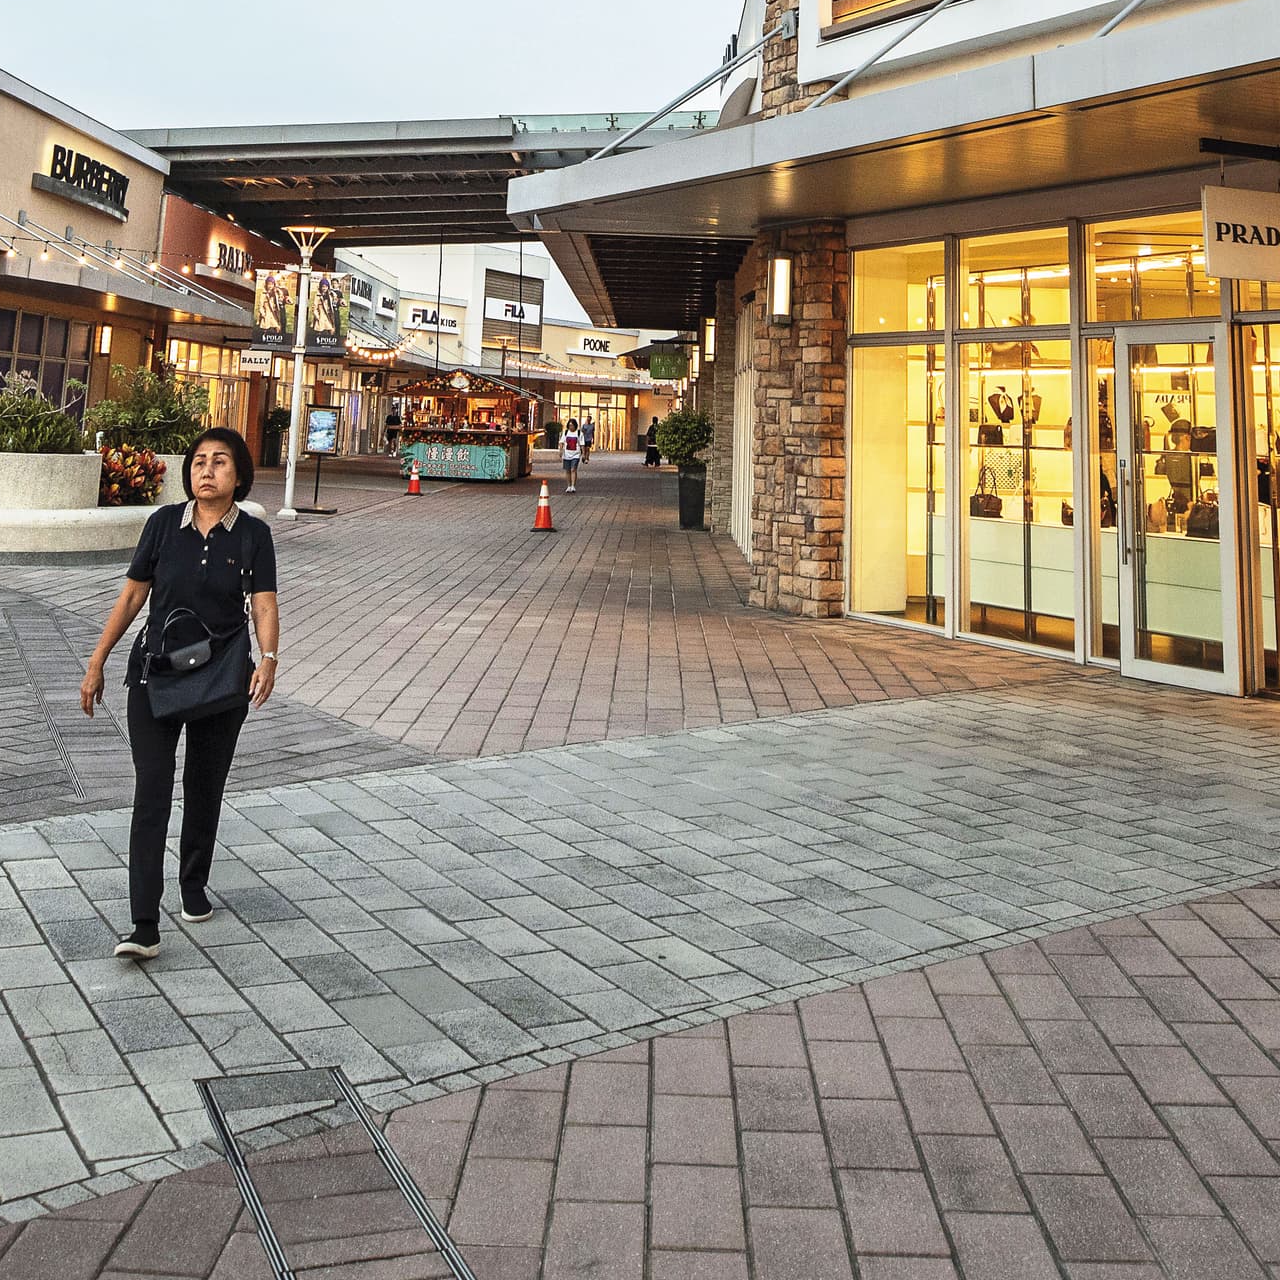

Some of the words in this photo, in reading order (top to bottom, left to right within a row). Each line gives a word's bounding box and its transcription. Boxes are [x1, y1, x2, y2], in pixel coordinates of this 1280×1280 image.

[50, 144, 130, 209] BURBERRY
[412, 308, 439, 325] FILA
[440, 317, 457, 328] KIDS
[504, 303, 525, 319] FILA
[583, 337, 611, 353] POONE
[241, 356, 270, 365] BALLY
